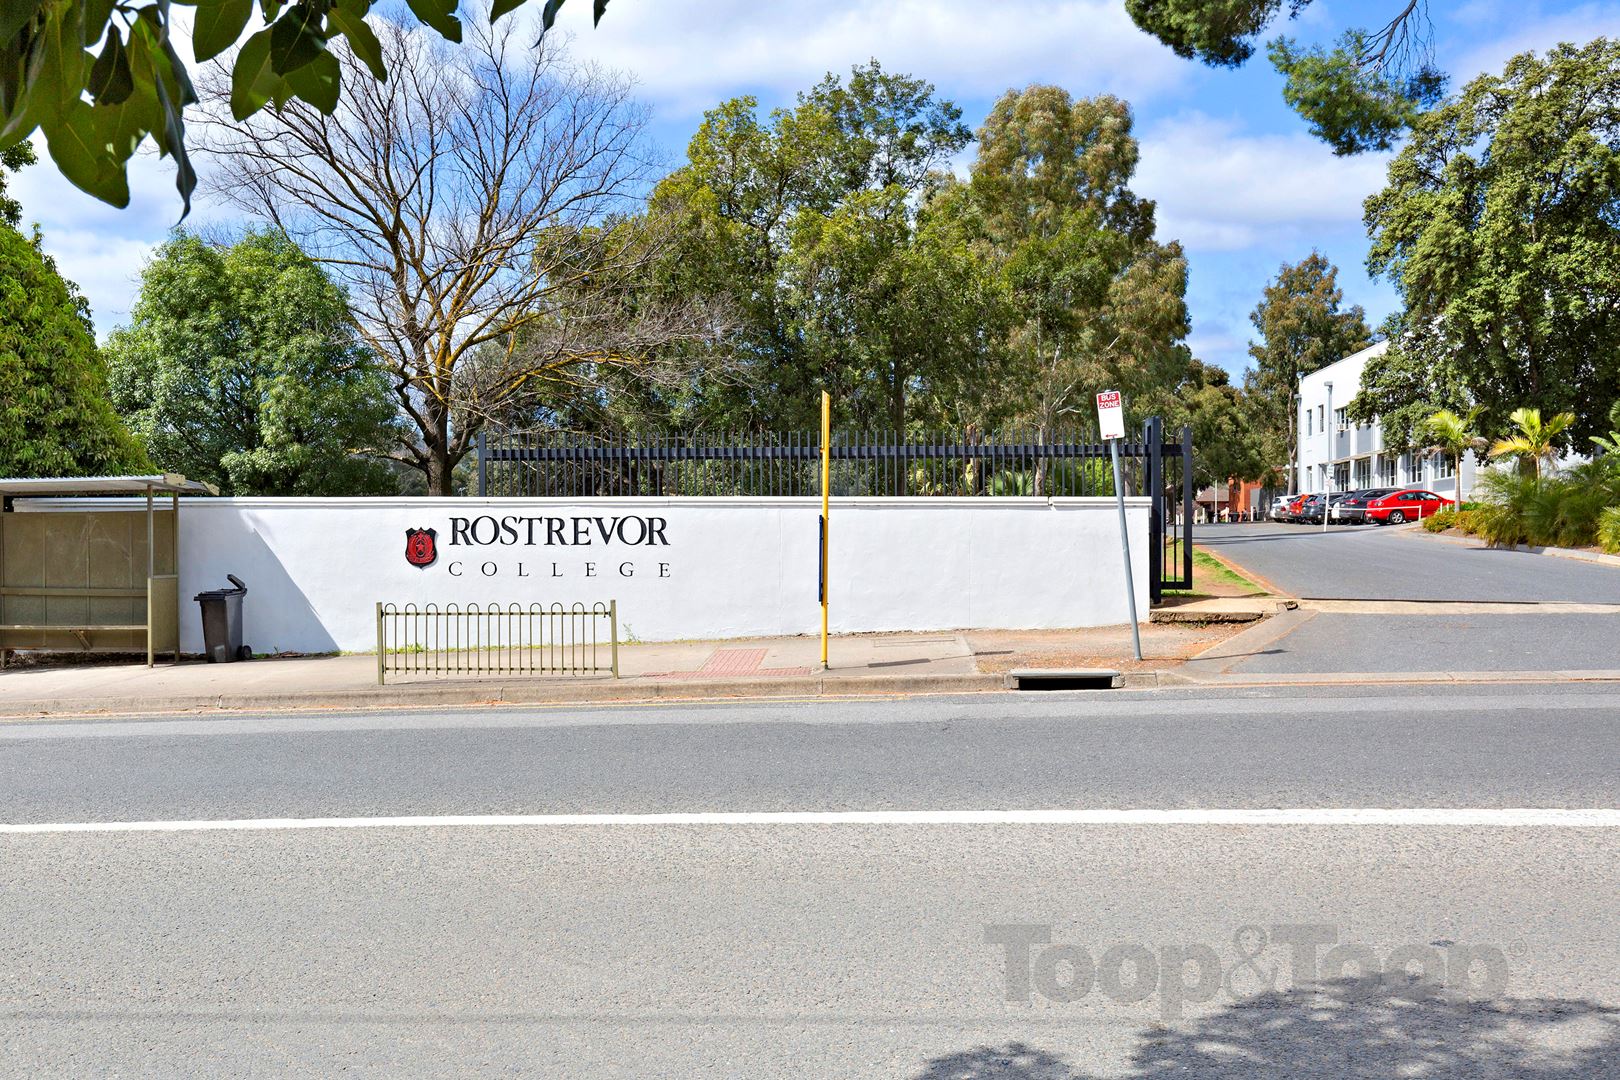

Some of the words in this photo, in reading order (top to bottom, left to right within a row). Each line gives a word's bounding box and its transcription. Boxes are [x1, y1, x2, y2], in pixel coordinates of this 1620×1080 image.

[1101, 393, 1116, 401] BUS
[448, 515, 671, 546] ROSTREVOR
[448, 561, 671, 578] COLLEGE
